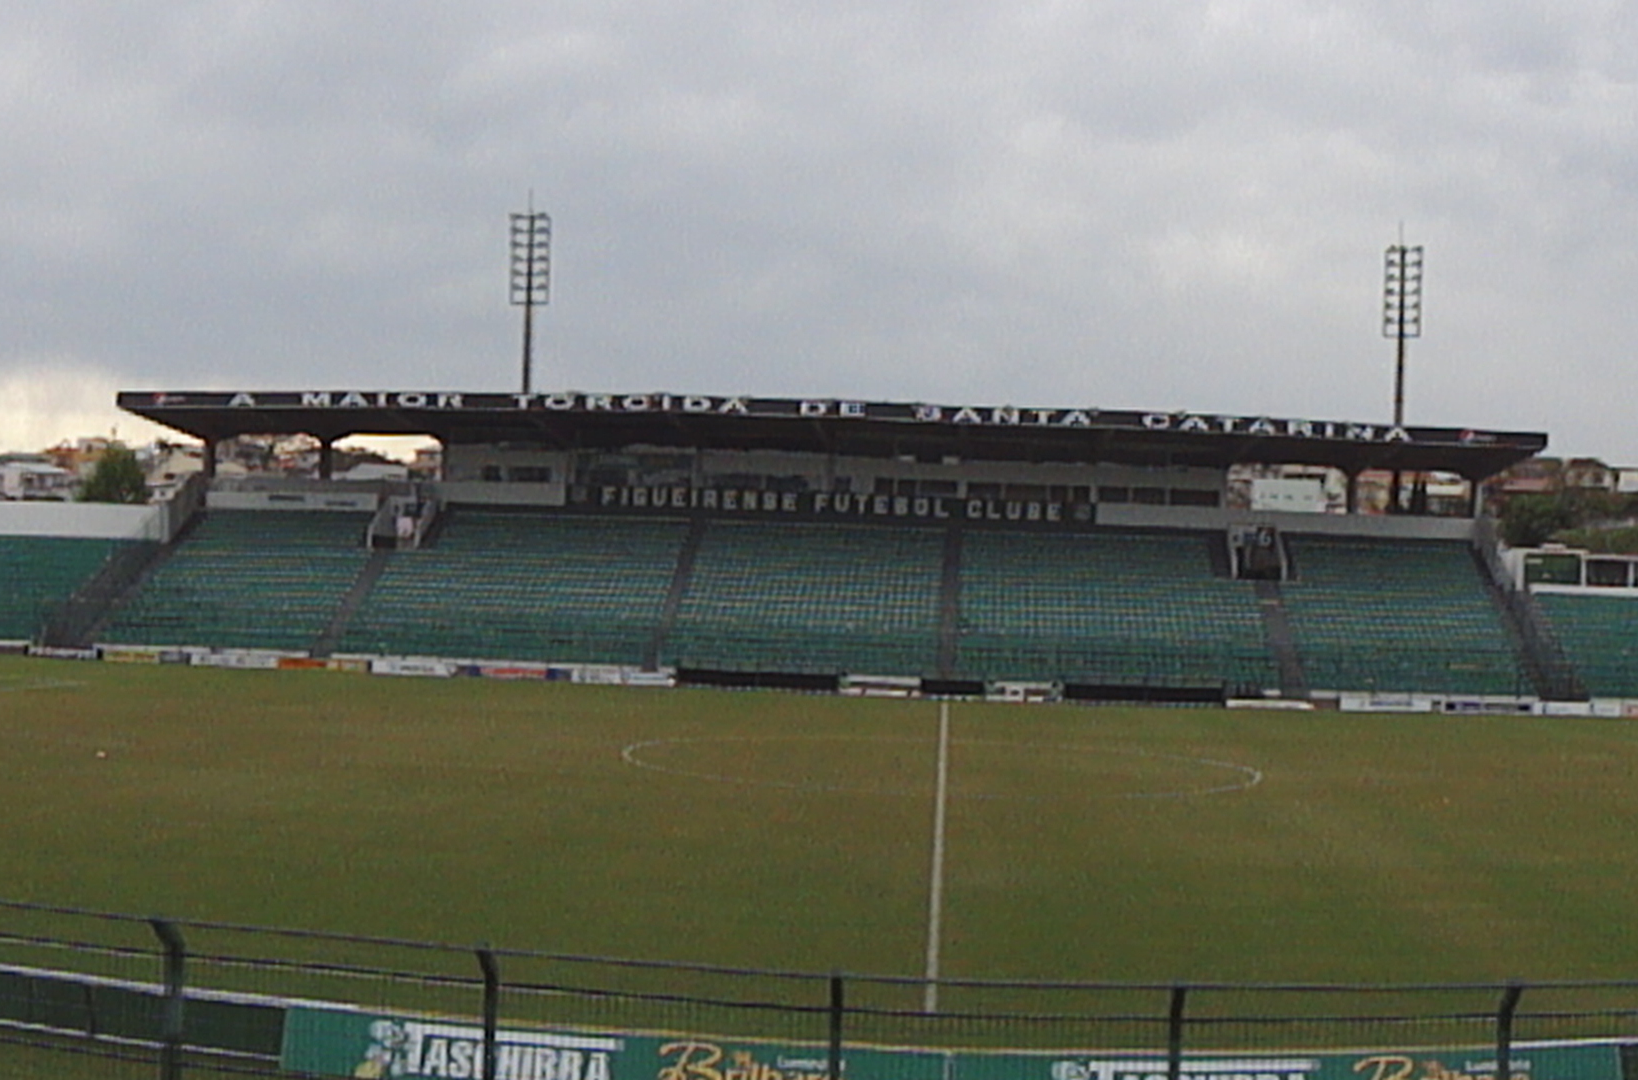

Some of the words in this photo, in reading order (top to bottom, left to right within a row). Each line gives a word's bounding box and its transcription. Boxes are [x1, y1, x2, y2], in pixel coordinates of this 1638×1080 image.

[228, 393, 255, 408] A
[301, 393, 465, 409] MAIOR
[512, 393, 749, 415] TORCIDA
[799, 401, 865, 416] DE
[915, 405, 1091, 427] SANTA
[1142, 412, 1411, 442] CATARINA
[601, 486, 797, 512] FIGUEIRENSE
[815, 494, 949, 517] FUTEBOL
[967, 500, 1061, 520] CLUBE
